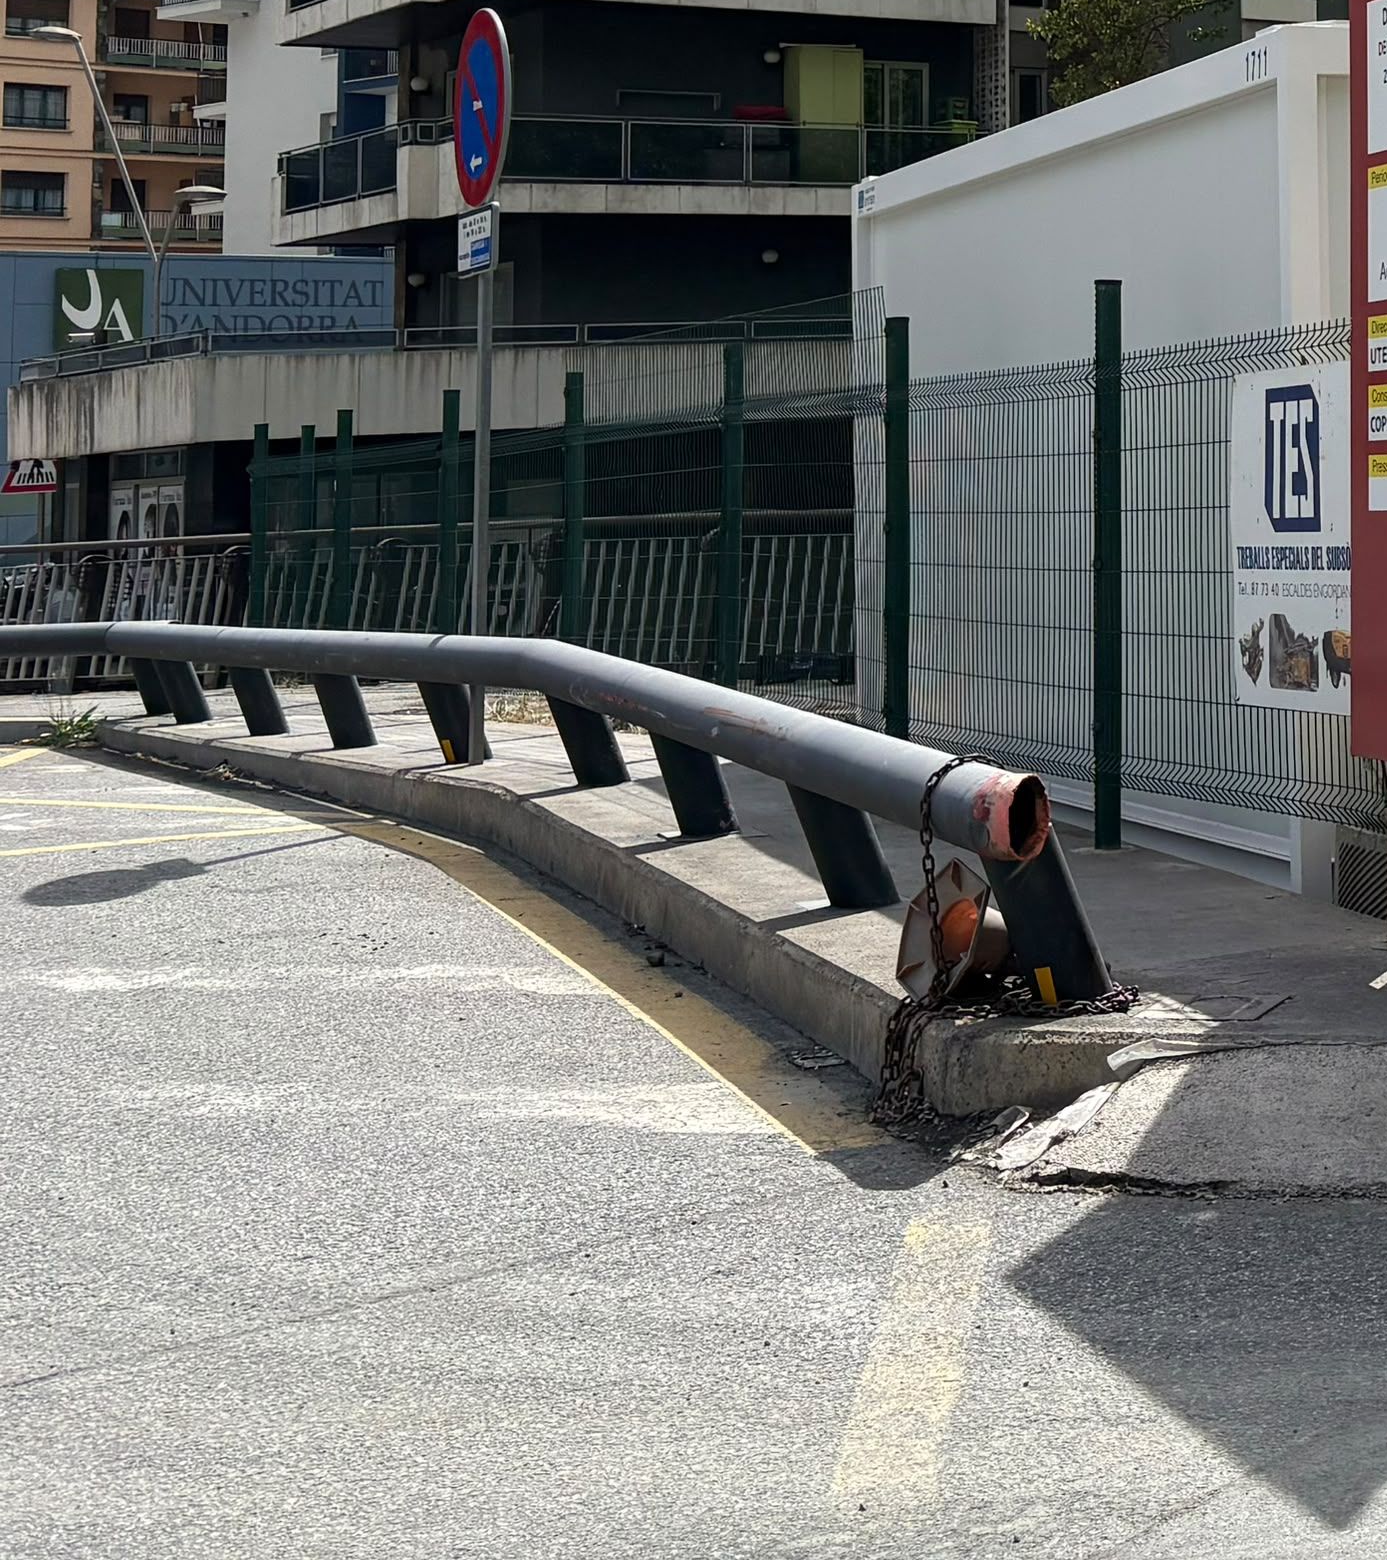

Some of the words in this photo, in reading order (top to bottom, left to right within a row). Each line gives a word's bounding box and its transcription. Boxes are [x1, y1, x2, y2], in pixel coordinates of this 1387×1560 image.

[1245, 45, 1267, 82] 1711
[1370, 346, 1387, 364] UTE
[1269, 399, 1315, 519] TES
[1236, 546, 1270, 570] TREBALLS
[1272, 546, 1310, 570] ESPECIALS
[1311, 546, 1325, 570] DEL
